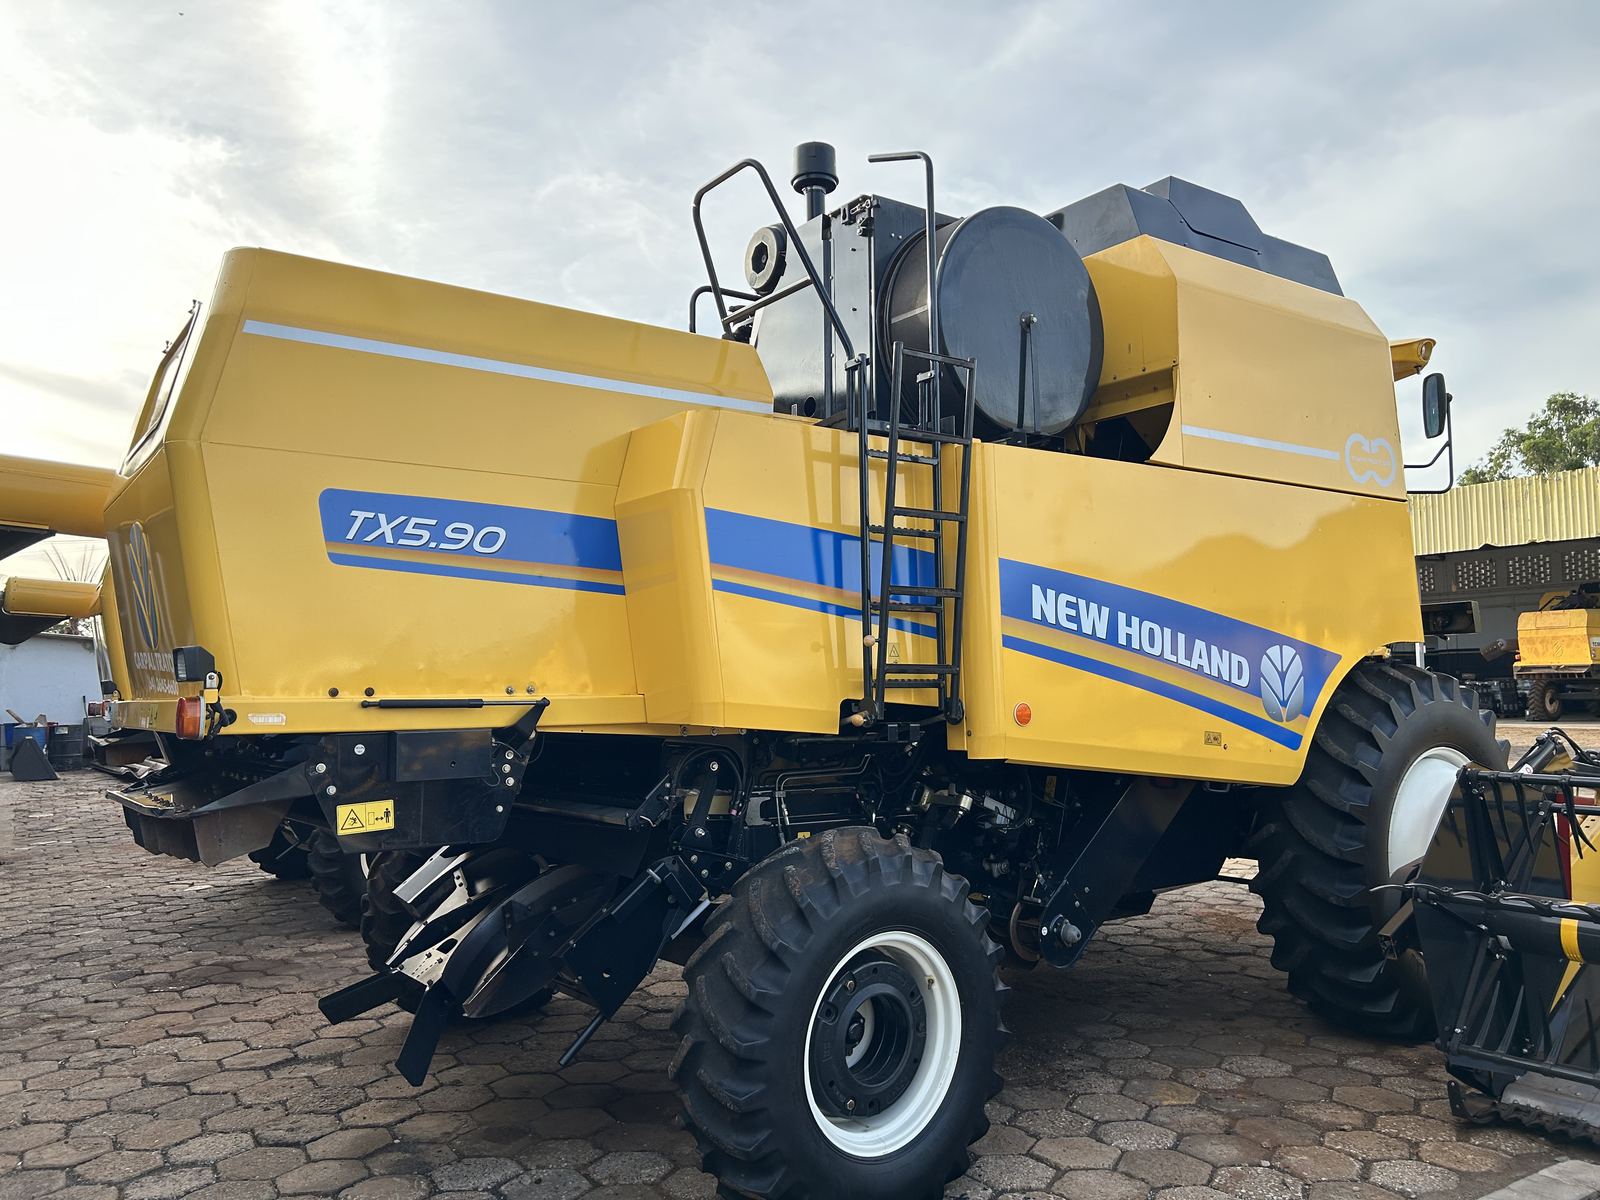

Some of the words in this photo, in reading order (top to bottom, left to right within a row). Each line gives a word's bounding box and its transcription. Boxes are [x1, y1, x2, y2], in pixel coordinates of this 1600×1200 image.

[345, 509, 507, 555] TX5.90
[1031, 583, 1110, 641] NEW
[1117, 610, 1251, 689] HOLLAND
